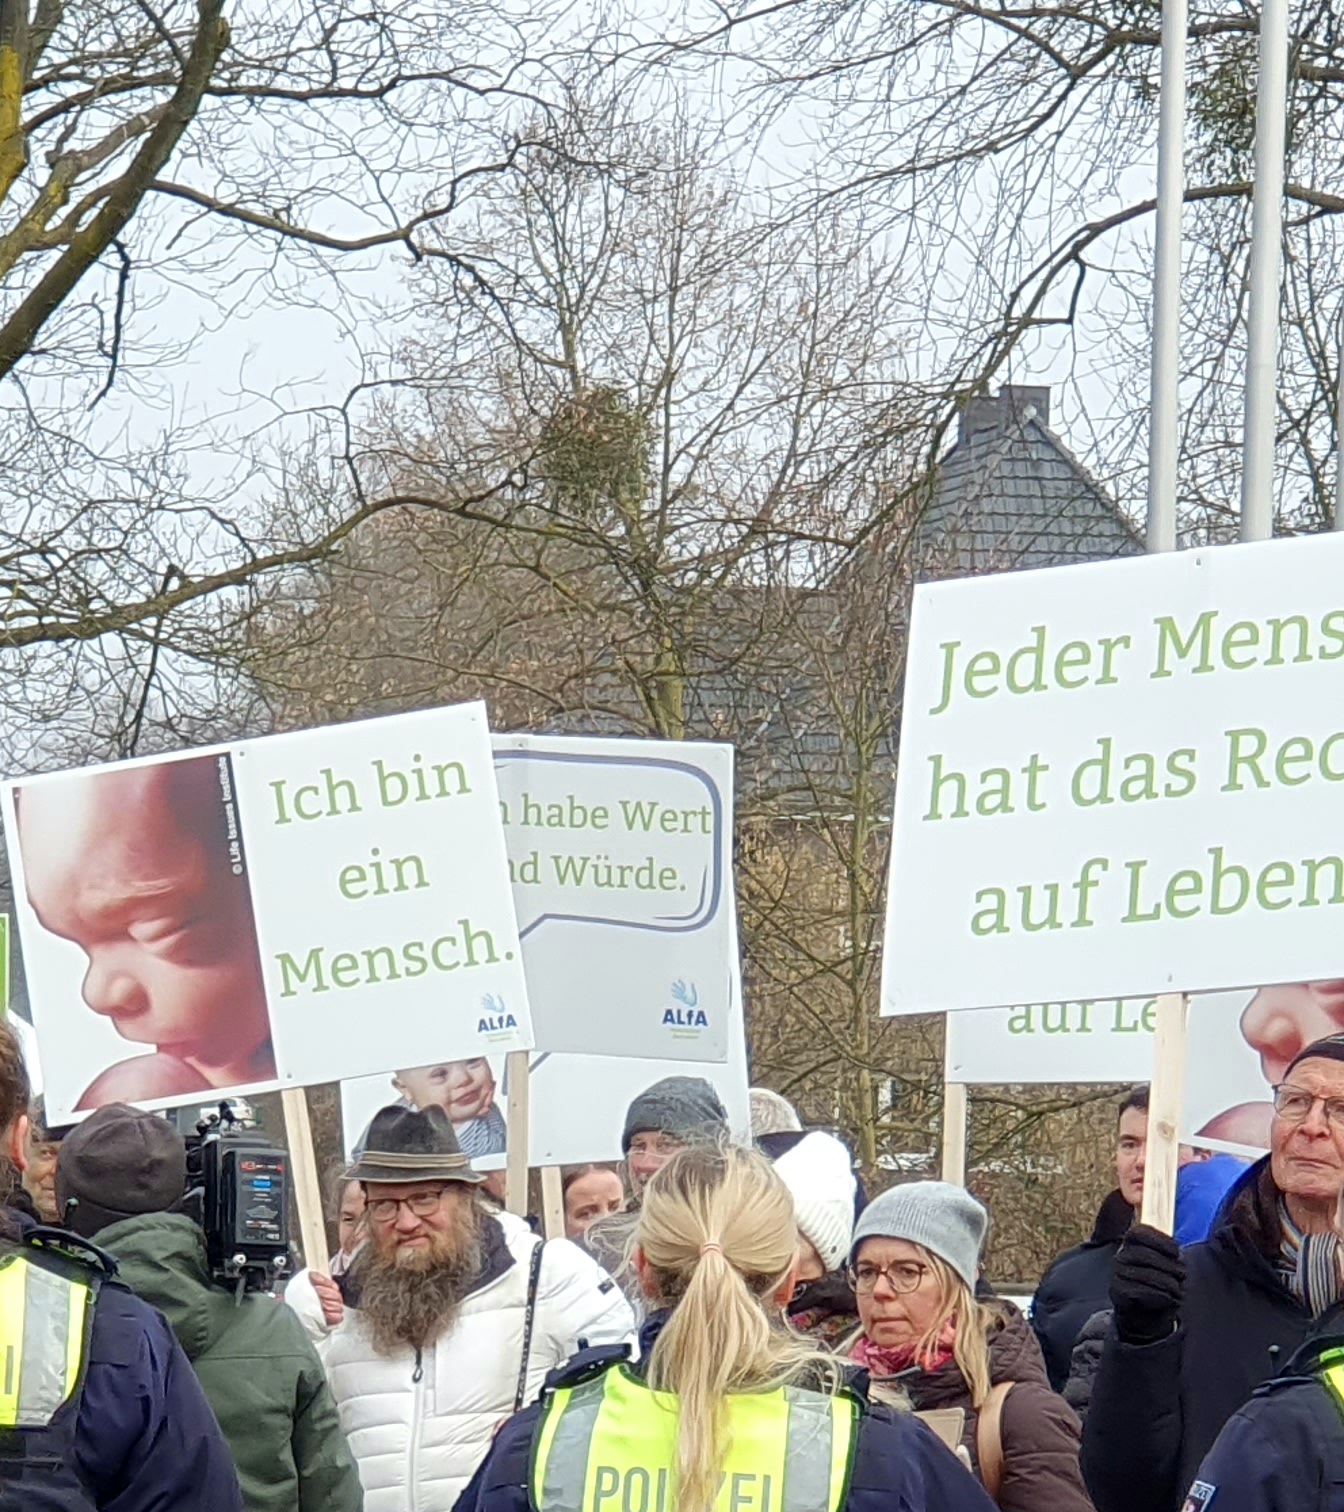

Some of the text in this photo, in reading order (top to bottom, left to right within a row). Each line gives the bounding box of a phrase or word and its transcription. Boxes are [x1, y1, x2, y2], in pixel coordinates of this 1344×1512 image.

[930, 625, 1132, 715] Jeder
[268, 753, 473, 826] Ich bin
[921, 752, 1049, 822] hat
[1070, 738, 1199, 808] das
[520, 793, 610, 829] habe
[619, 799, 712, 834] Wert
[230, 841, 241, 863] Life
[338, 846, 430, 901] ein
[550, 854, 686, 891] Würde.
[970, 857, 1108, 936] auf
[276, 919, 514, 998] Mensch.
[478, 1014, 517, 1033] ALfA
[662, 1008, 709, 1027] ALfA
